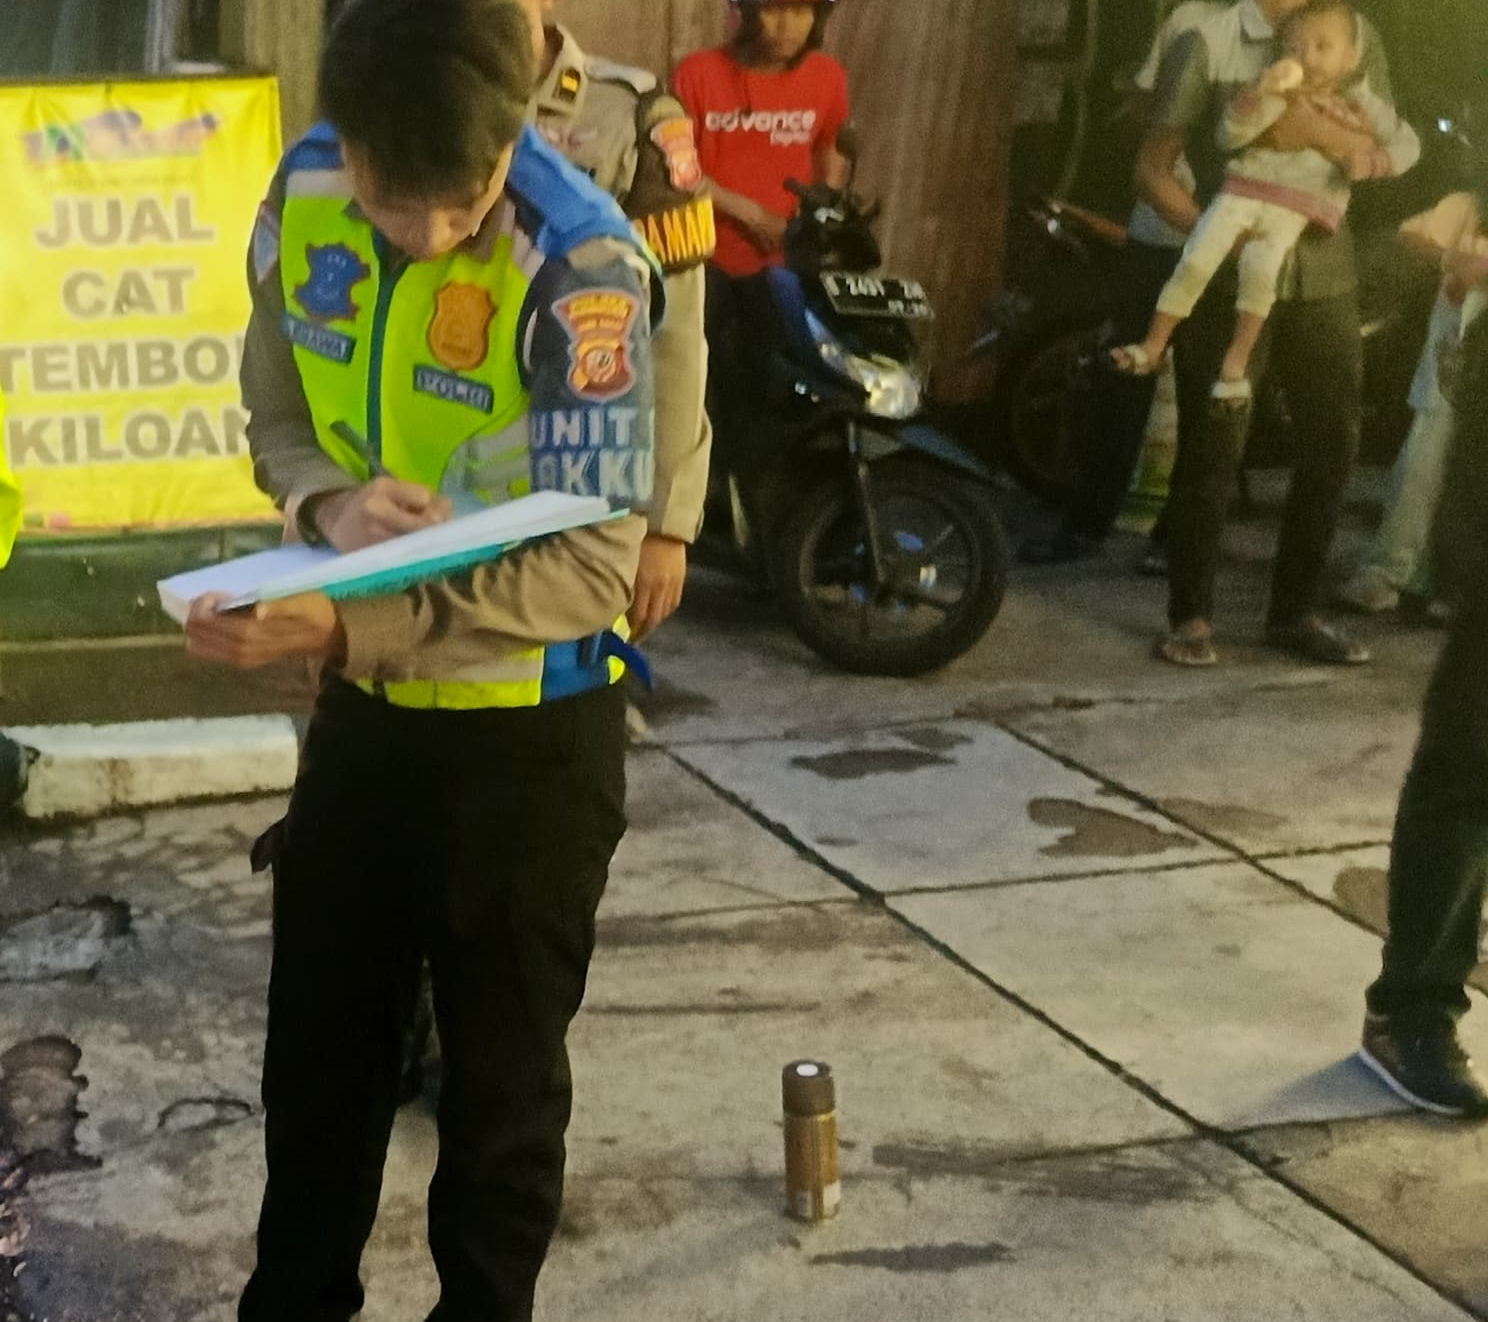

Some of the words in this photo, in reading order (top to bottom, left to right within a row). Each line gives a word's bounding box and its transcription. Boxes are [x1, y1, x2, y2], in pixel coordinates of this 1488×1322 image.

[36, 195, 214, 248] JUAL
[62, 267, 194, 318] CAT
[532, 407, 637, 447] UNIT
